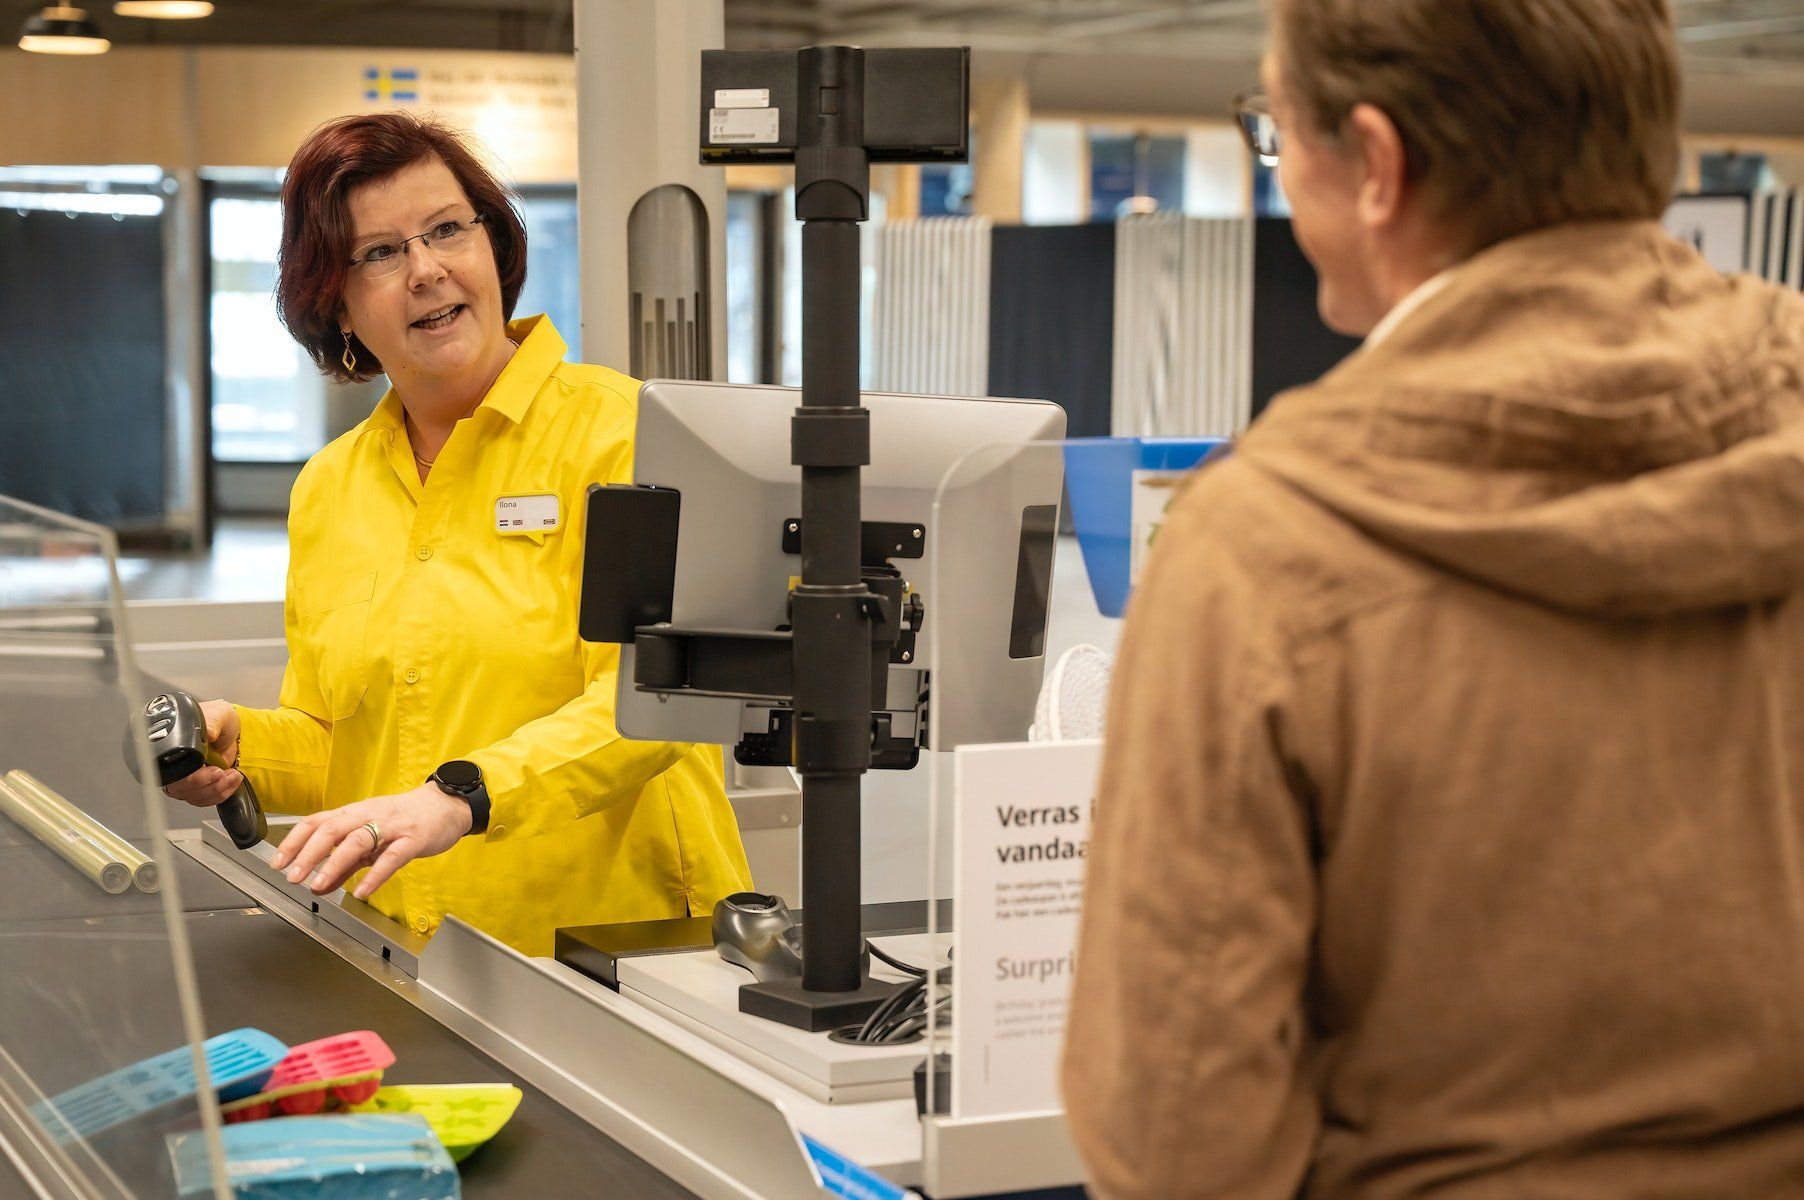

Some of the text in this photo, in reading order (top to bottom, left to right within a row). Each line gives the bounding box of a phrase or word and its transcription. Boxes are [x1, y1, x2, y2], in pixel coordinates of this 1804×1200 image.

[997, 805, 1080, 828] Verras
[997, 836, 1090, 864] vandaa
[995, 951, 1075, 983] Surpri
